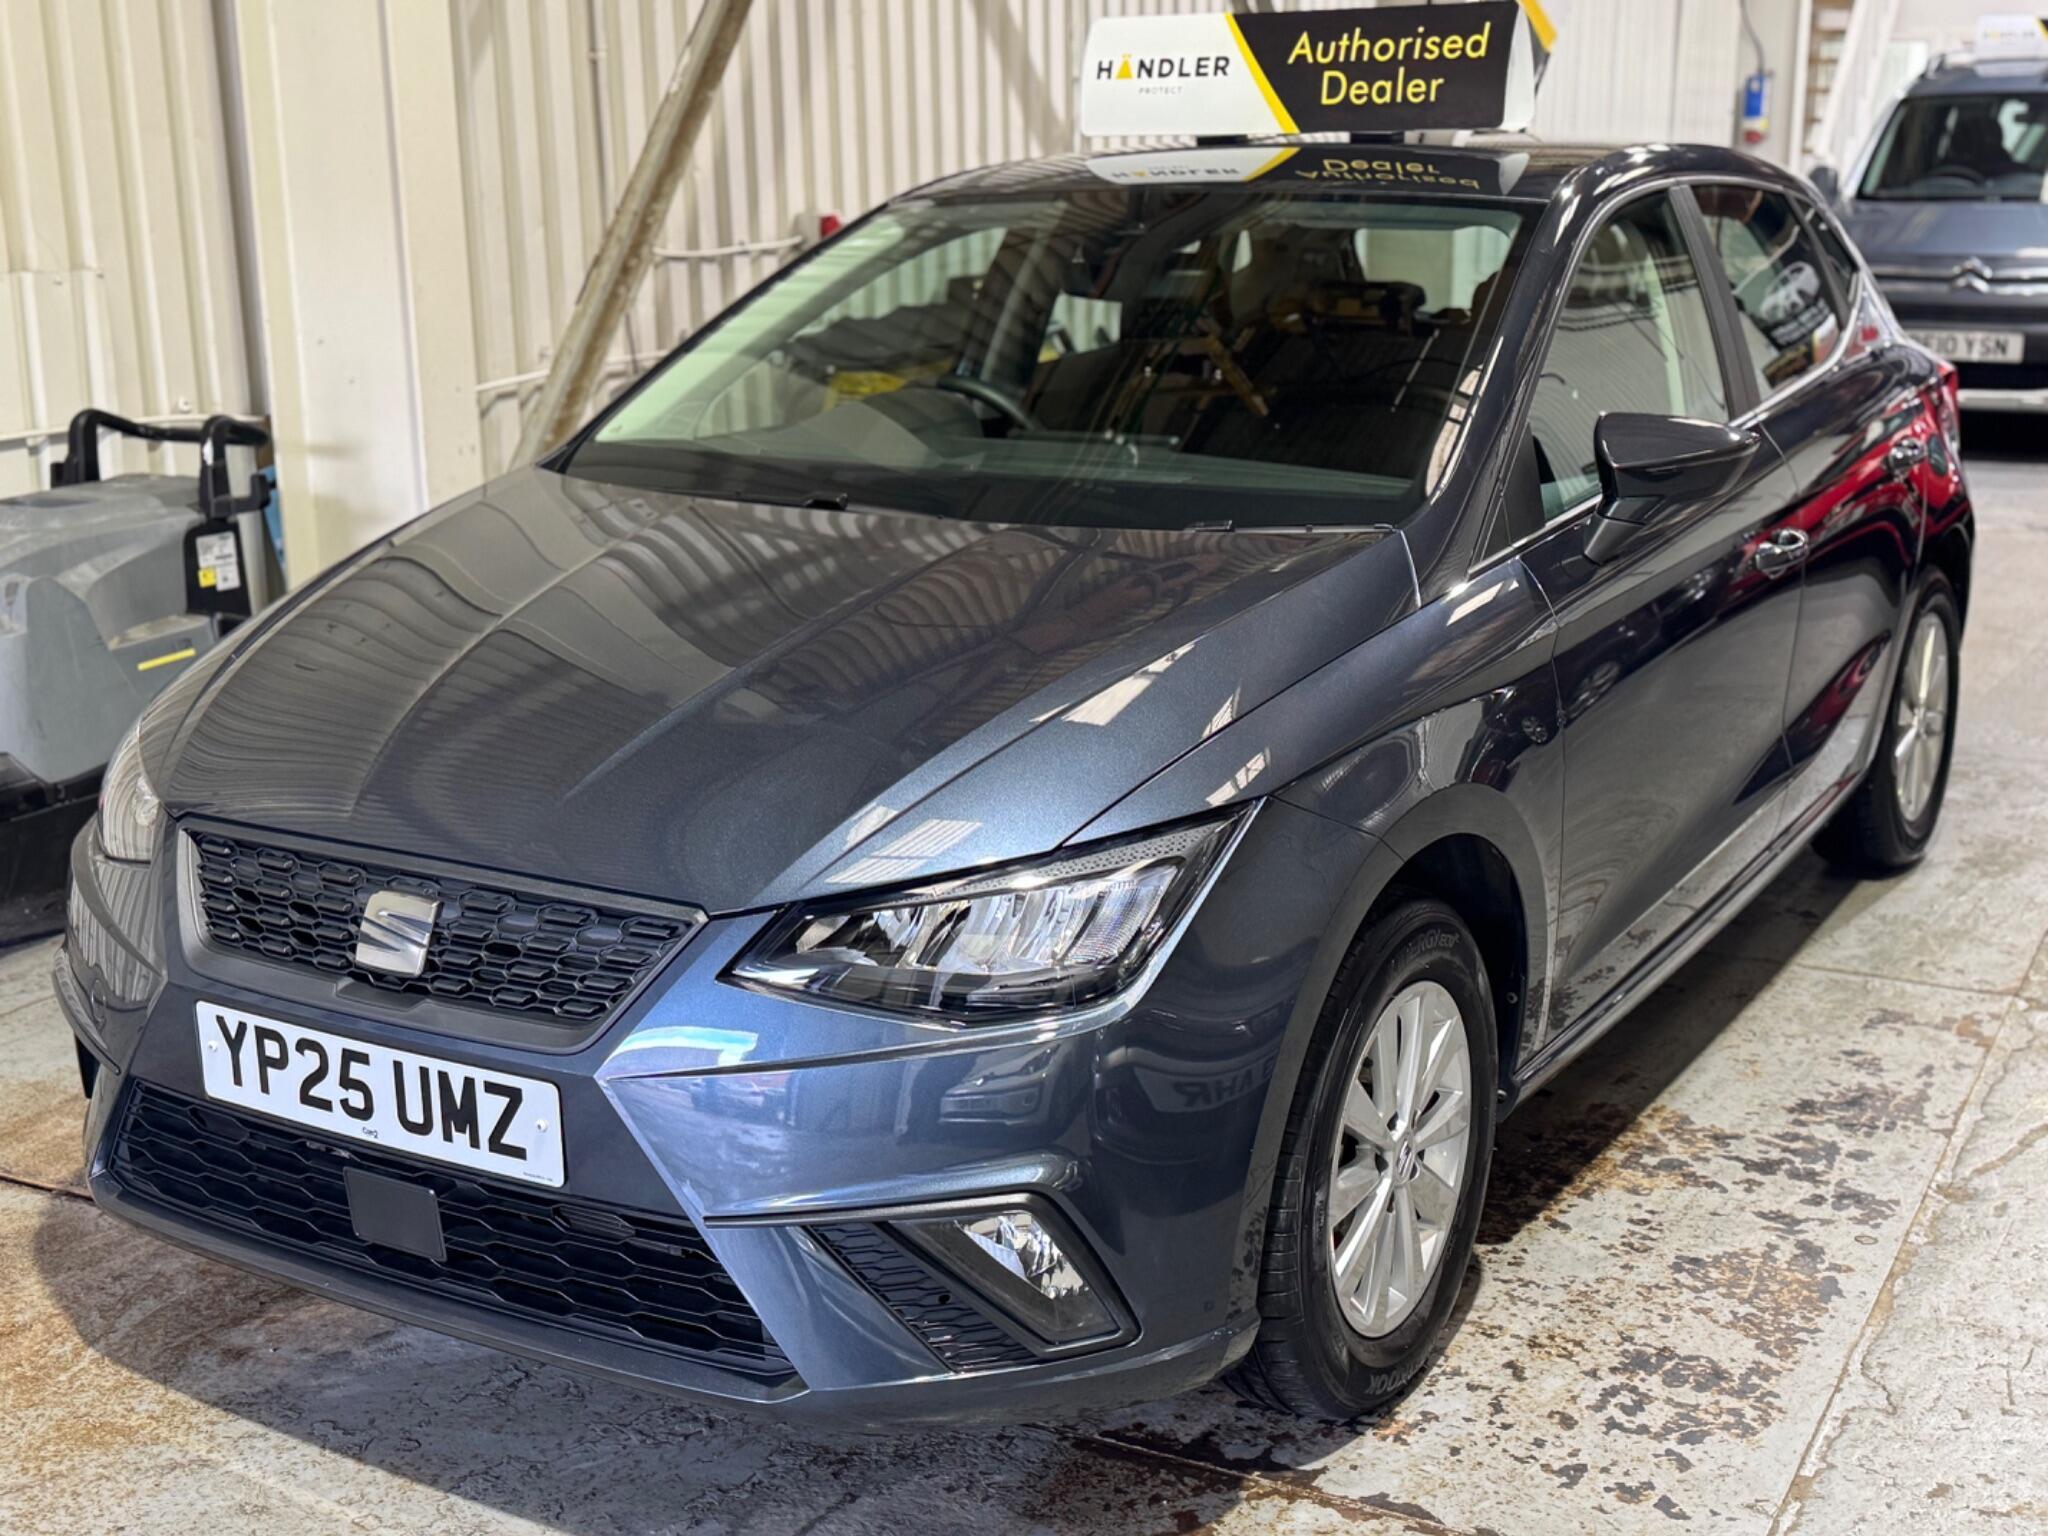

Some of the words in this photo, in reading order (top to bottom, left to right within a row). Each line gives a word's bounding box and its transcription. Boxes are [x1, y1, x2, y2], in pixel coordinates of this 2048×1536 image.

[1287, 21, 1491, 65] Authorised
[1138, 86, 1183, 95] PROTECT
[1320, 67, 1445, 106] Dealer
[216, 1015, 374, 1121] YP25
[393, 1060, 527, 1161] UMZ
